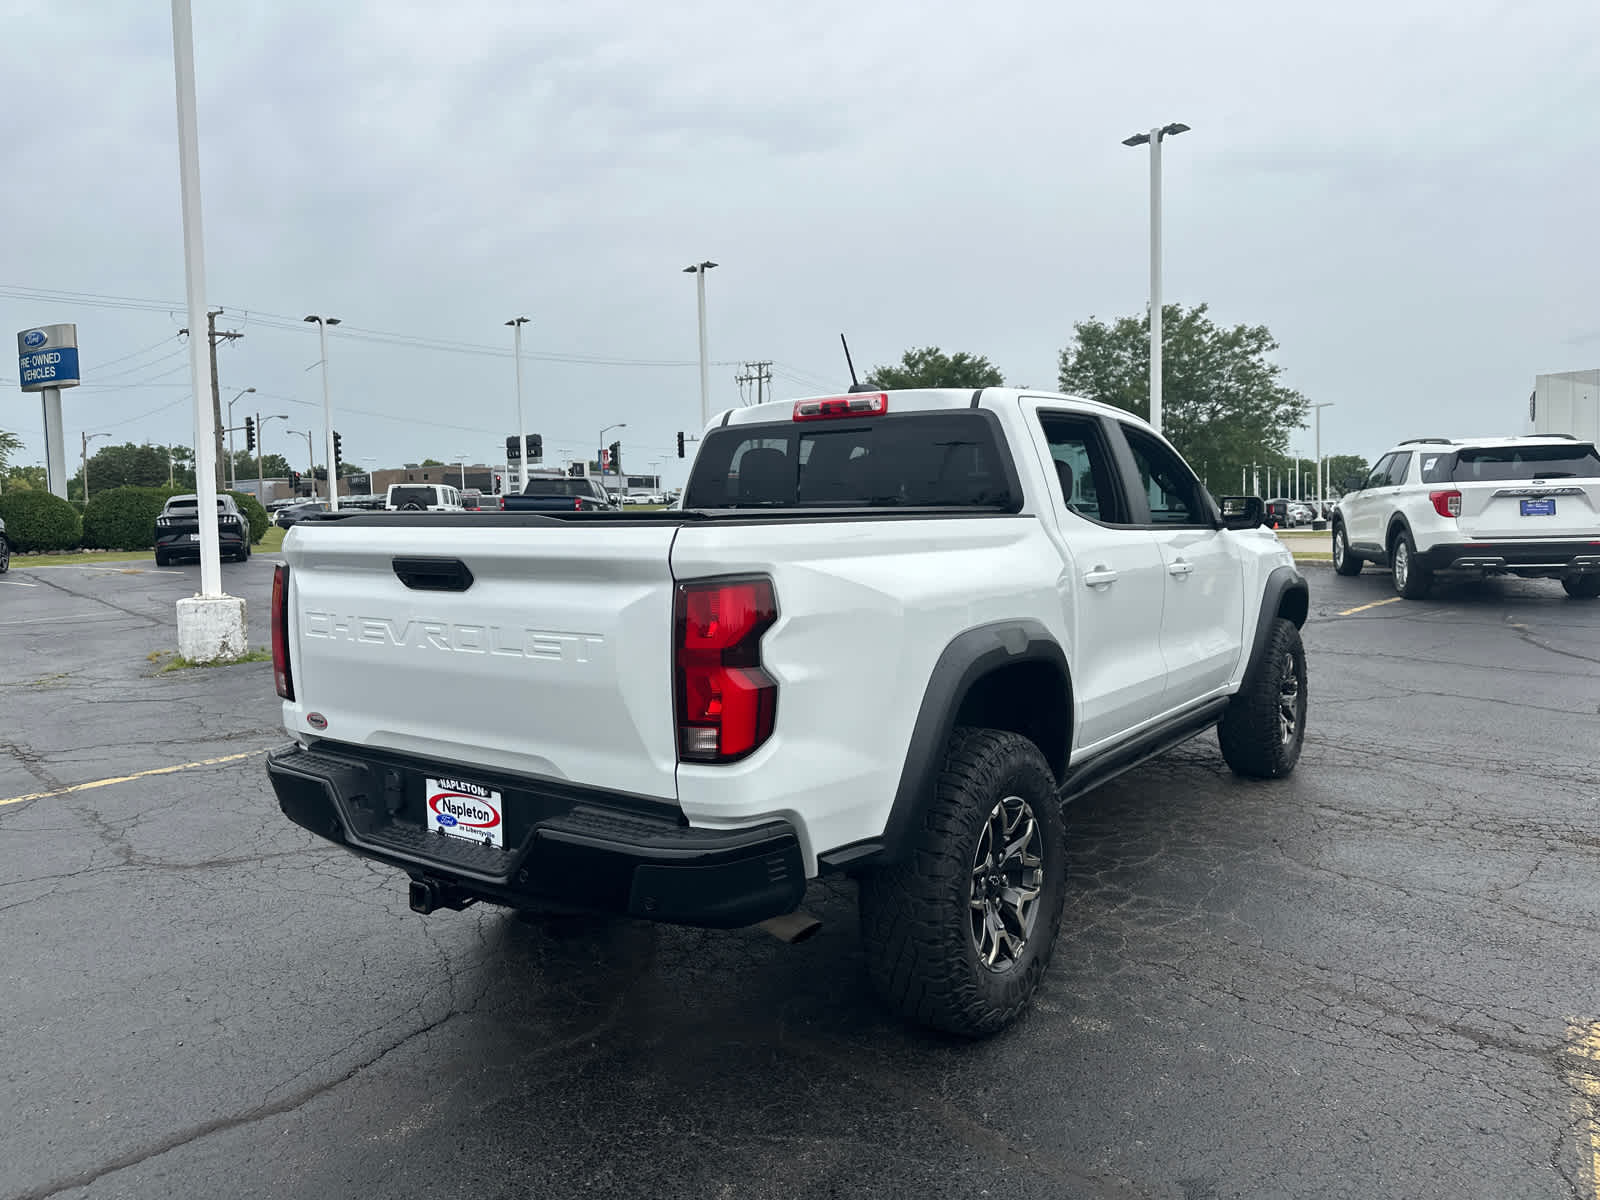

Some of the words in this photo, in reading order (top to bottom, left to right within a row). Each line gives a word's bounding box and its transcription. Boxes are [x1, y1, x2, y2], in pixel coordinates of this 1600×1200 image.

[21, 352, 61, 368] PRE-OWNED
[24, 366, 56, 382] VEHICLES
[508, 449, 535, 457] LINLN
[304, 610, 605, 663] CHEVROLET
[439, 778, 486, 796] NAPLETON
[442, 798, 490, 822] Napleton
